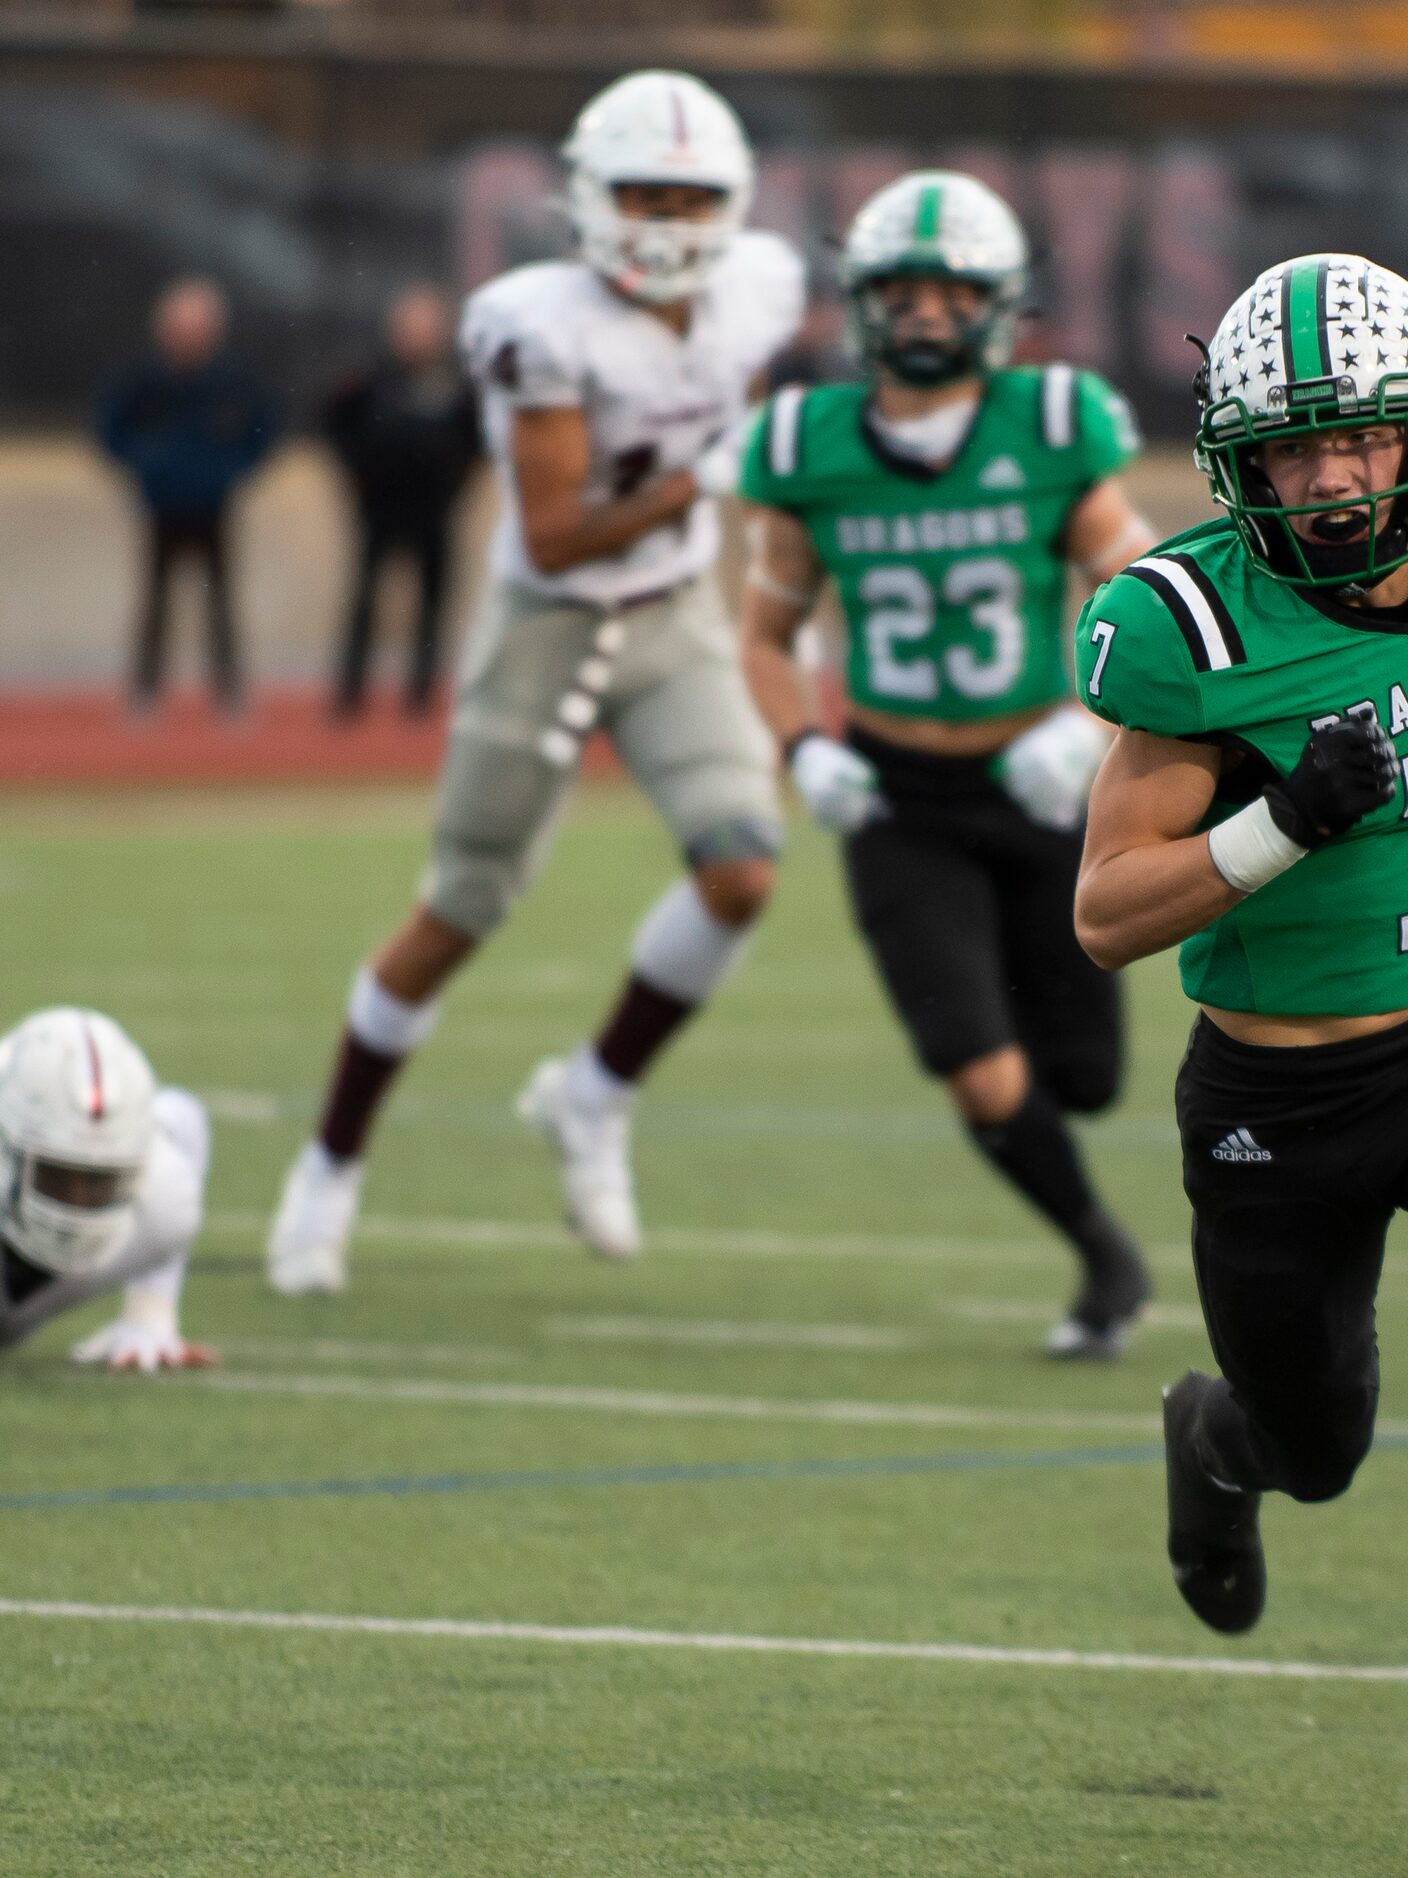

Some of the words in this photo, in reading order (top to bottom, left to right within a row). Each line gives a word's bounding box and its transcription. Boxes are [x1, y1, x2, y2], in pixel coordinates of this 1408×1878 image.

[858, 558, 1025, 700] 23
[1089, 618, 1119, 699] 7
[1212, 1148, 1272, 1161] adidas
